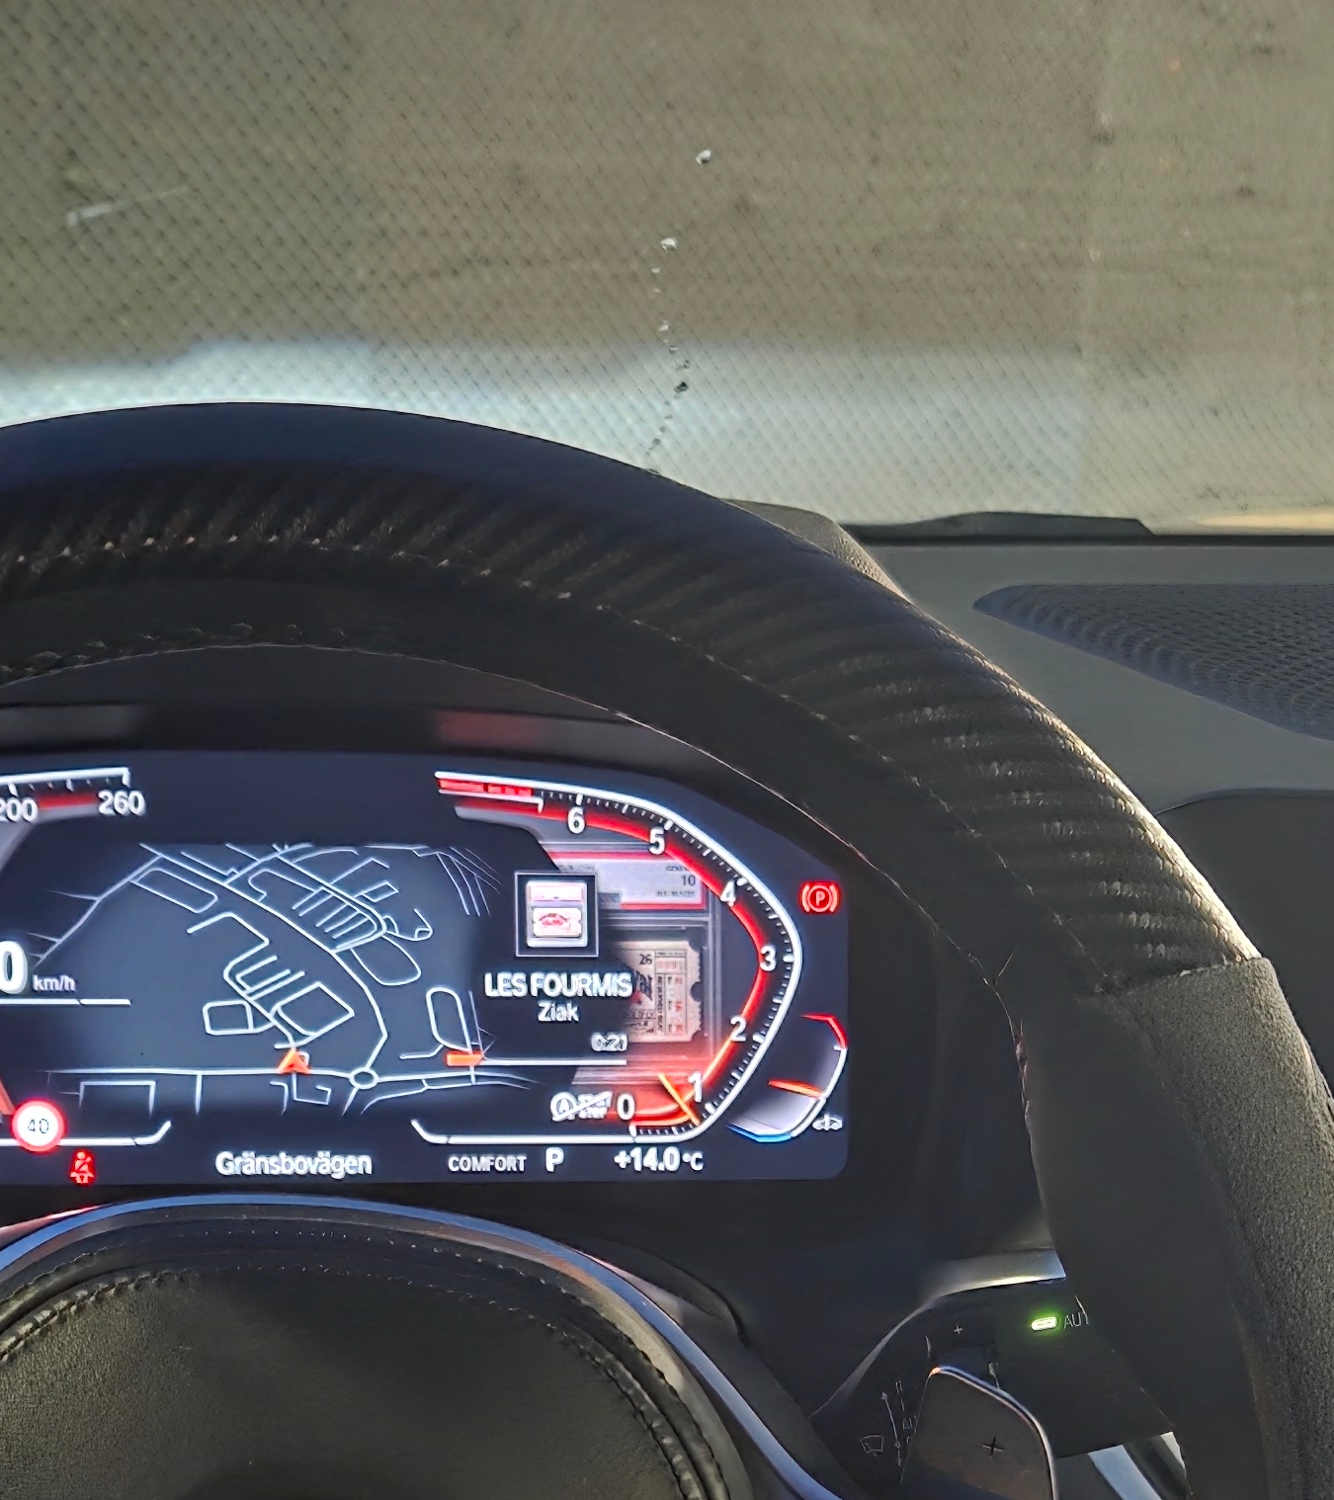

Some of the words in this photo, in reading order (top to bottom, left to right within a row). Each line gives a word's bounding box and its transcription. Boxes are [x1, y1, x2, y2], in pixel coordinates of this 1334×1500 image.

[98, 790, 145, 816] 260
[567, 808, 585, 834] 6
[648, 827, 666, 855] 5
[720, 880, 736, 907] 4
[761, 946, 777, 971] 3
[32, 974, 76, 993] km/h
[484, 972, 527, 998] LES
[530, 972, 634, 998] FOURMIS
[537, 1001, 579, 1022] Ziak
[730, 1016, 746, 1042] 2
[688, 1072, 703, 1102] 1
[617, 1093, 636, 1121] 0
[27, 1117, 49, 1134] 40
[215, 1151, 373, 1180] Gränsbovägen
[448, 1155, 528, 1173] COMFORT
[545, 1147, 565, 1173] P
